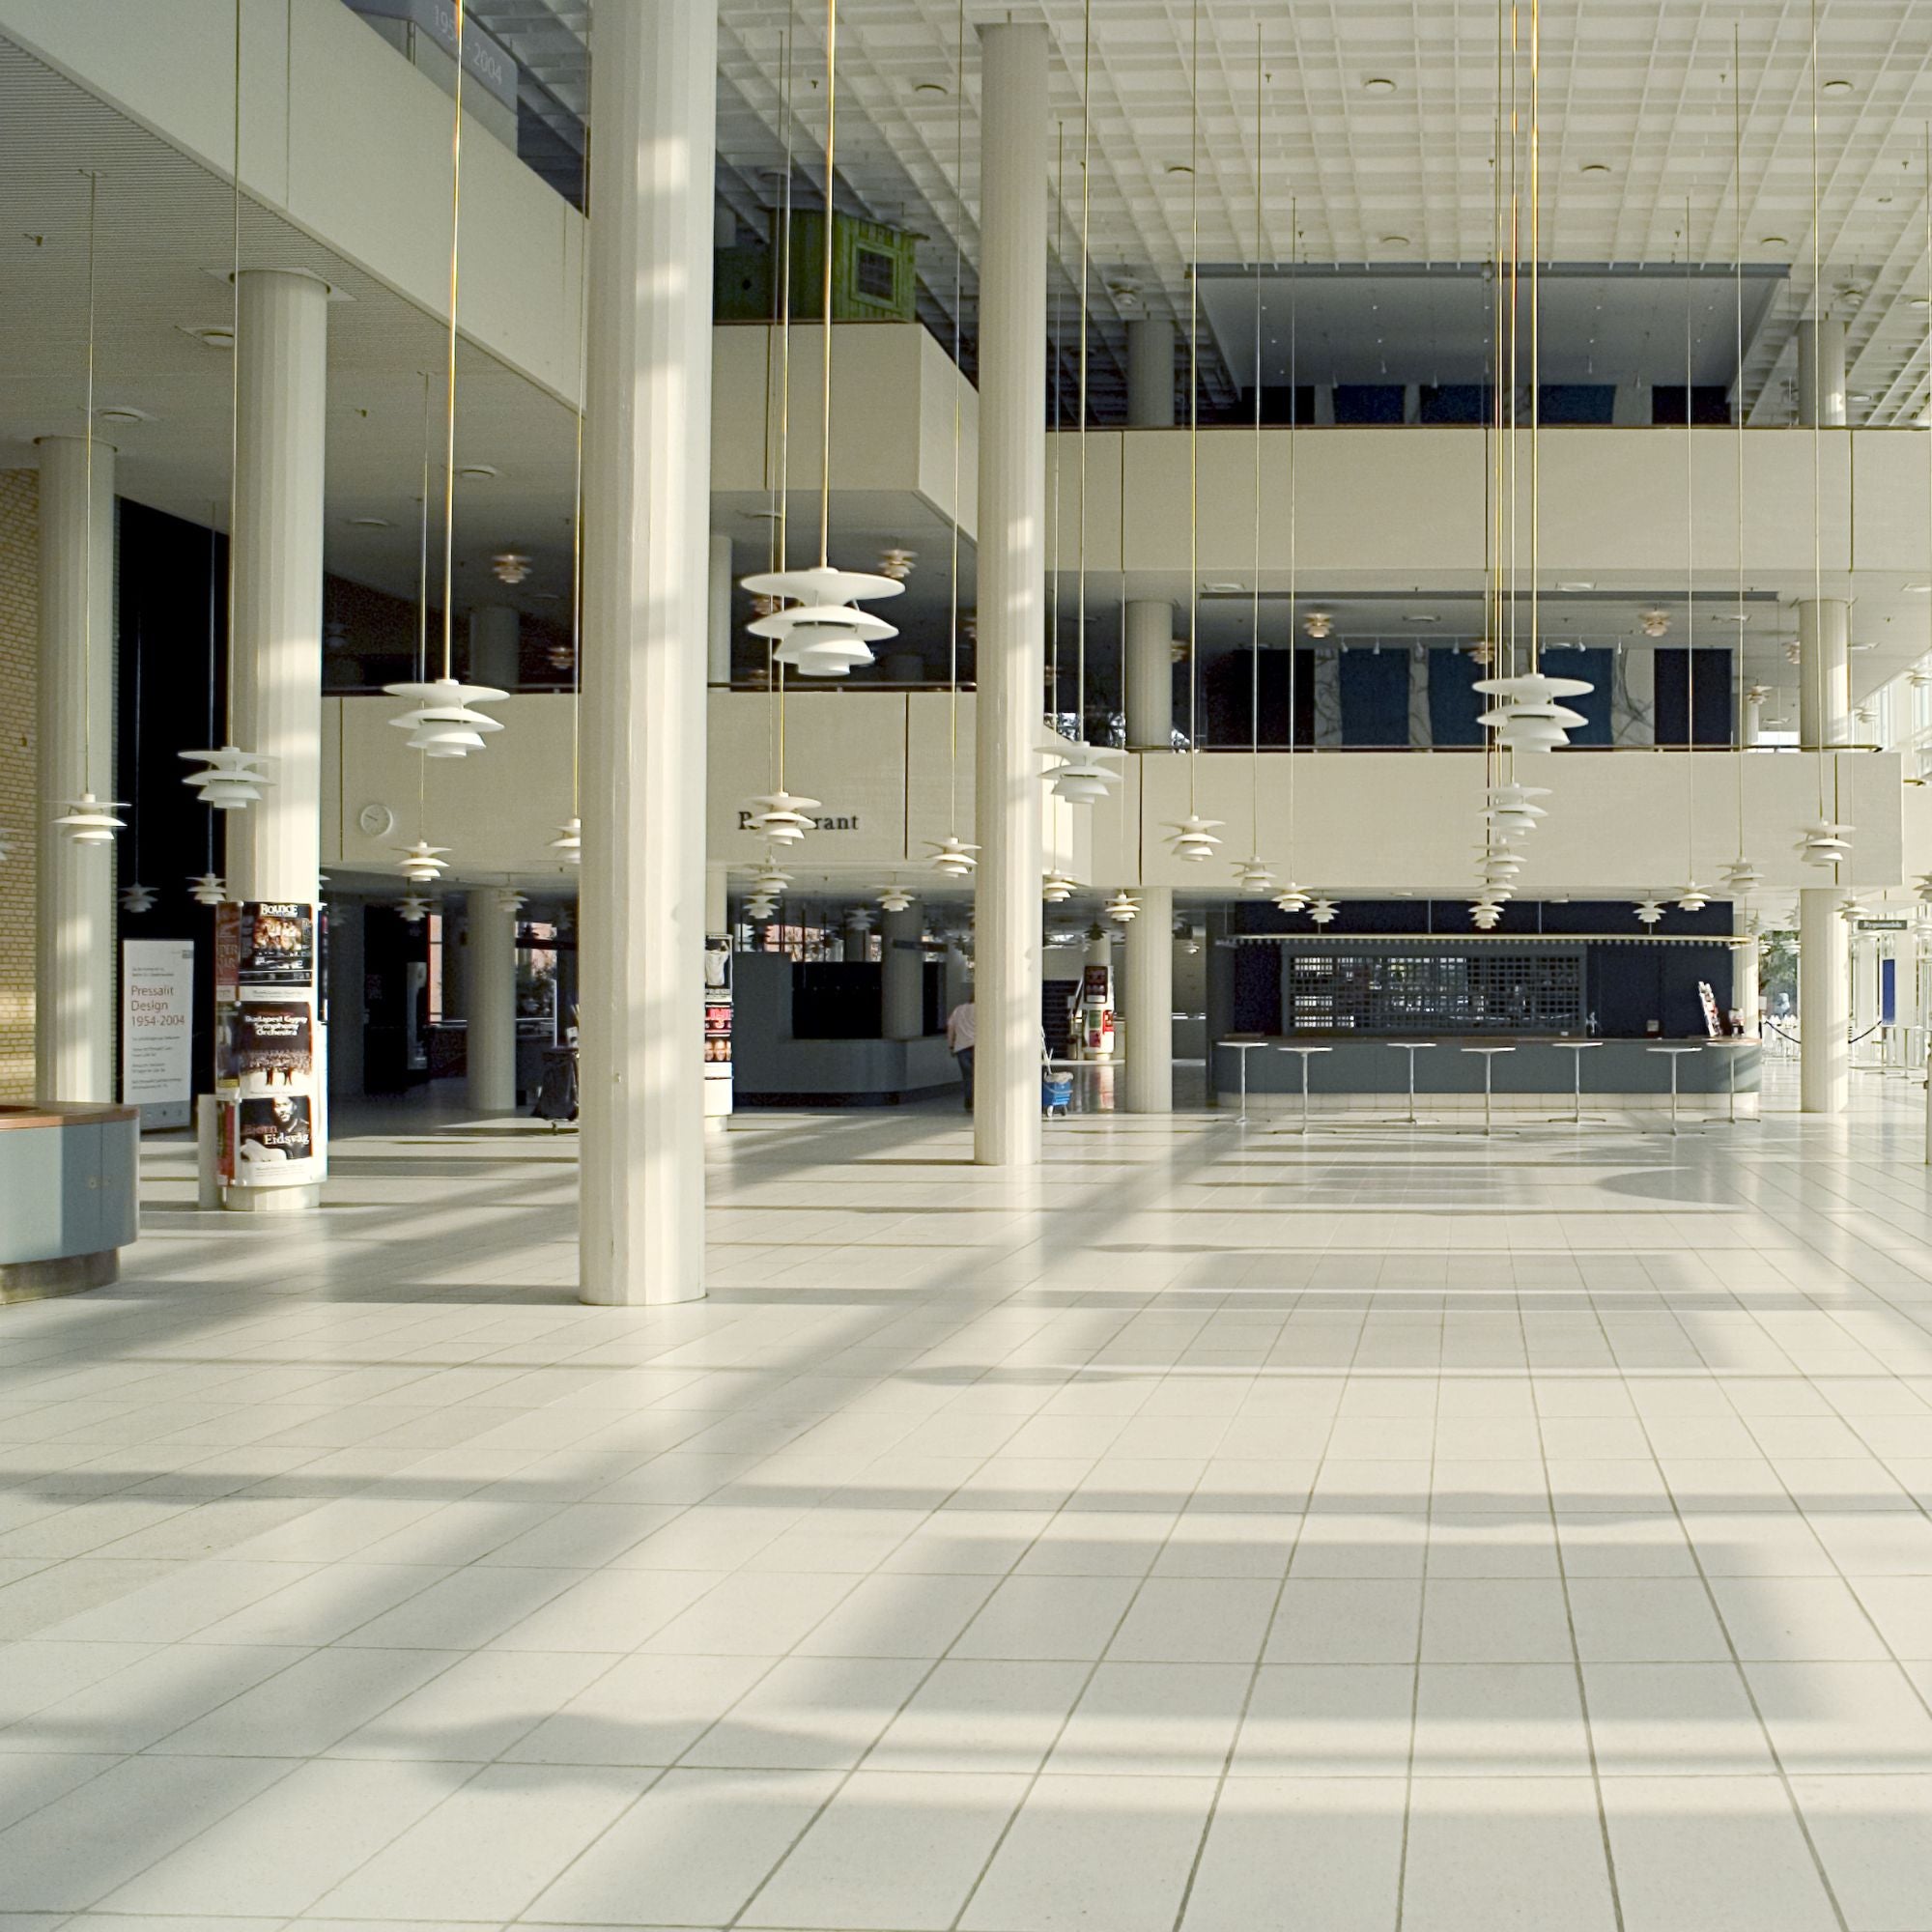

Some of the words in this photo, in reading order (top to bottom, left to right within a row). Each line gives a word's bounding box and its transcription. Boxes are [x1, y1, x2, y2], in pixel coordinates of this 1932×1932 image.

[738, 811, 859, 830] Rrant
[131, 985, 174, 996] Pressalit
[131, 1000, 168, 1013] Design
[131, 1015, 185, 1027] 1954-2004
